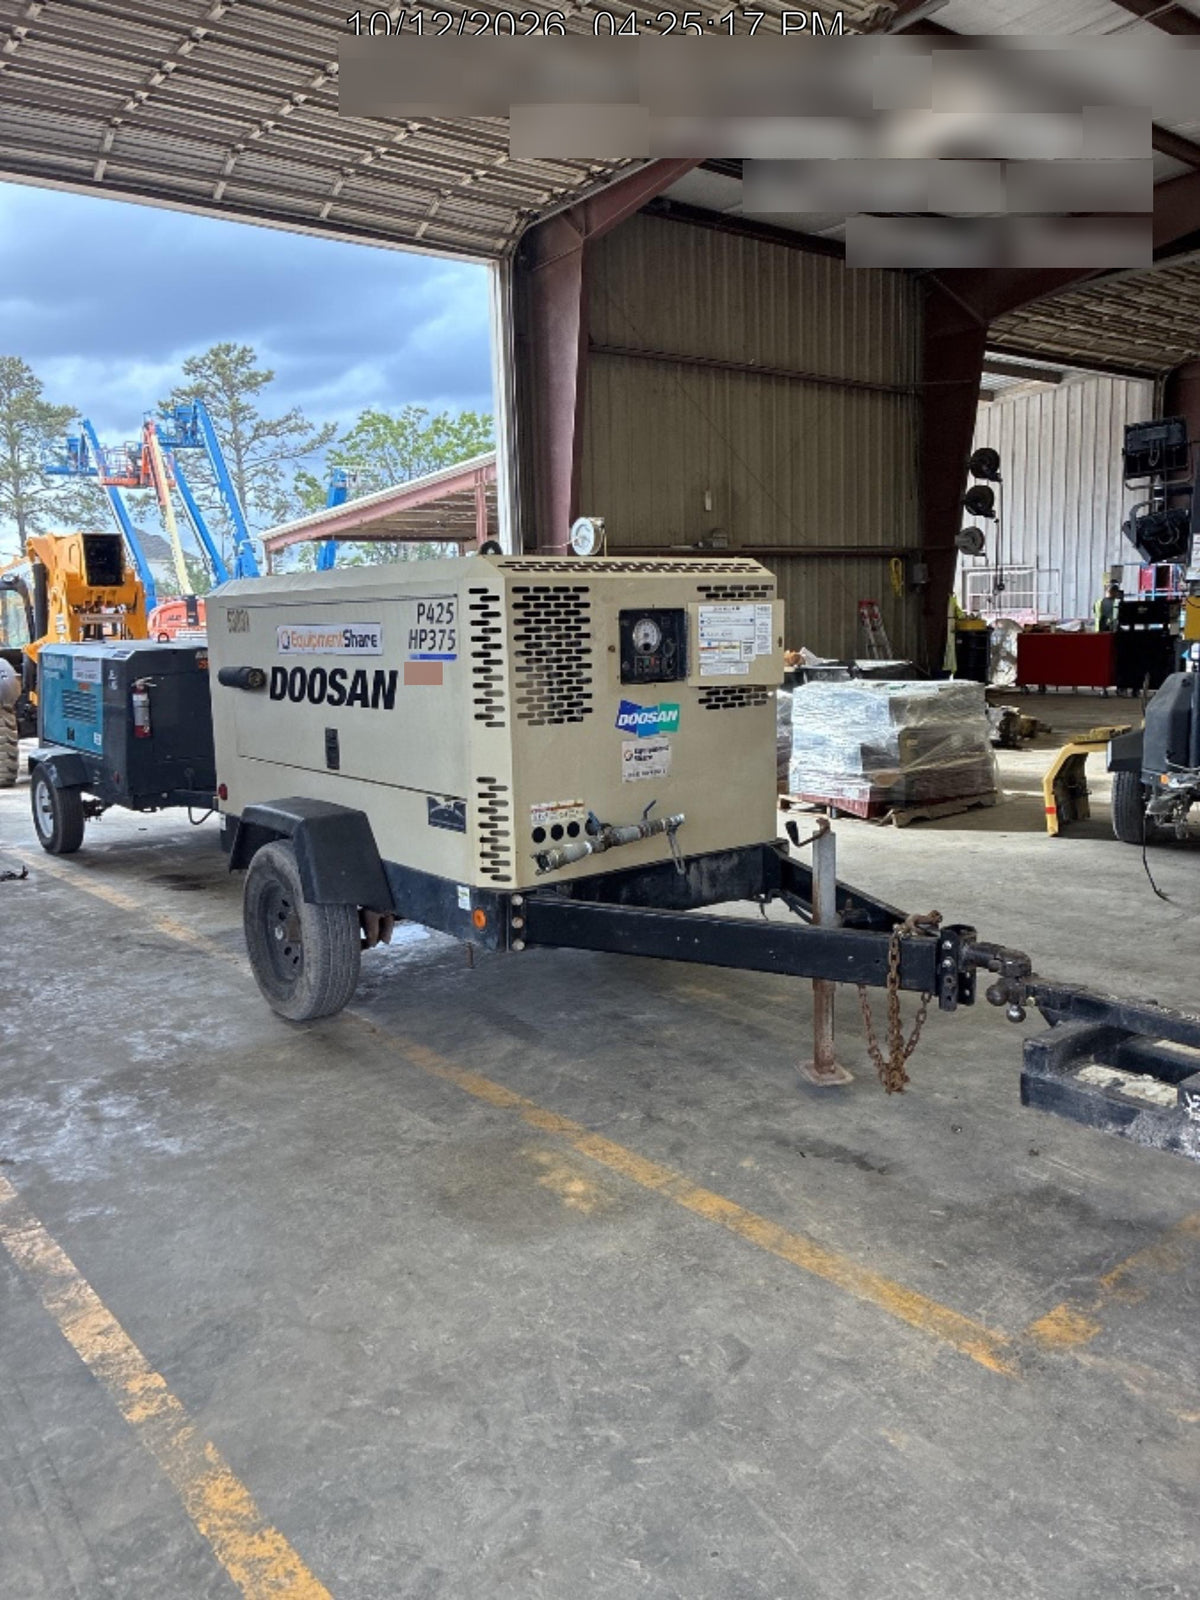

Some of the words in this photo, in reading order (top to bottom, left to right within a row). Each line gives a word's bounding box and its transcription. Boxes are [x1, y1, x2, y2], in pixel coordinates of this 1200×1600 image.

[416, 602, 455, 625] P425
[408, 629, 456, 651] HP375
[269, 666, 399, 710] DOOSAN
[618, 709, 678, 726] DOOSAN
